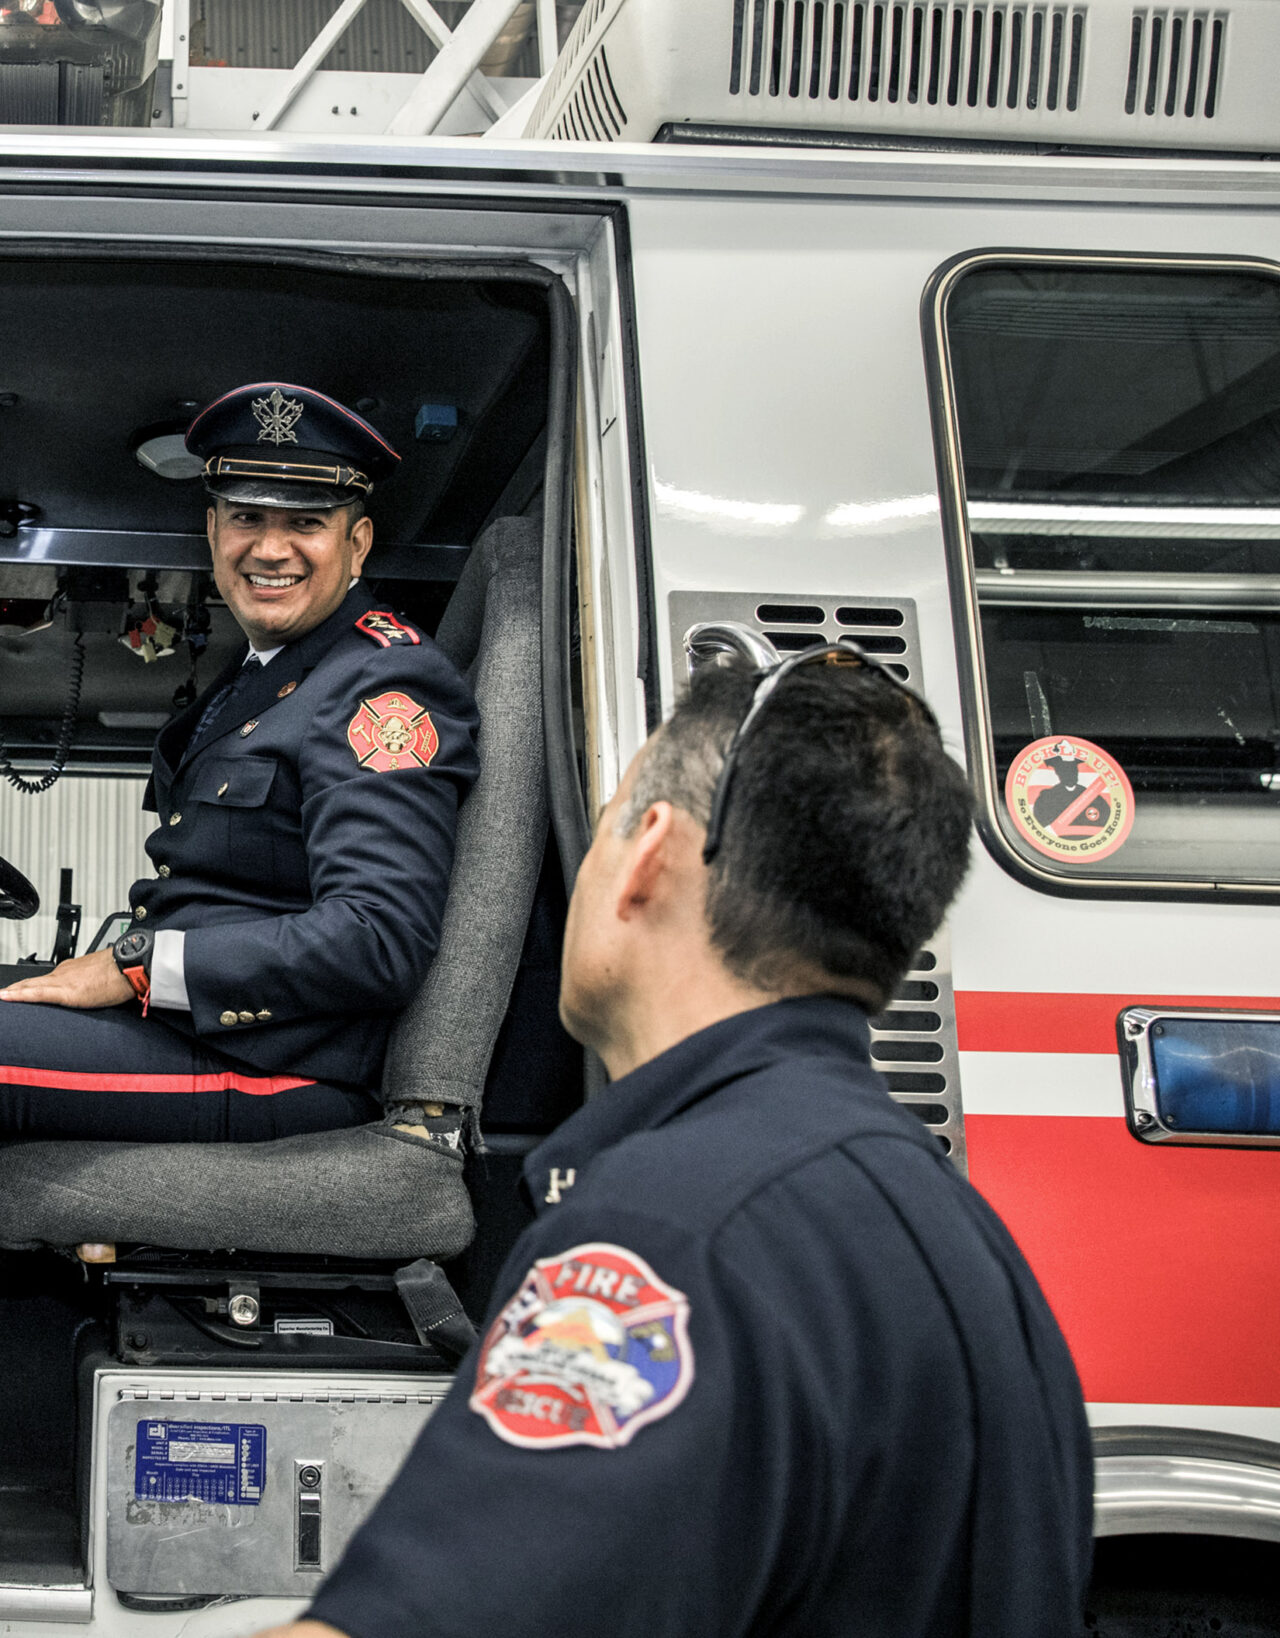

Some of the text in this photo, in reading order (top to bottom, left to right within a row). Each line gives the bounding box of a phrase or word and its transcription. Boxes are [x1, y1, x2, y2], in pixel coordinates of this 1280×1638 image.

[1015, 745, 1120, 788] BUCKLE UP!
[1018, 798, 1027, 812] So
[1024, 811, 1077, 851] Everyone
[1080, 835, 1108, 851] Goes
[553, 1260, 646, 1308] FIRE
